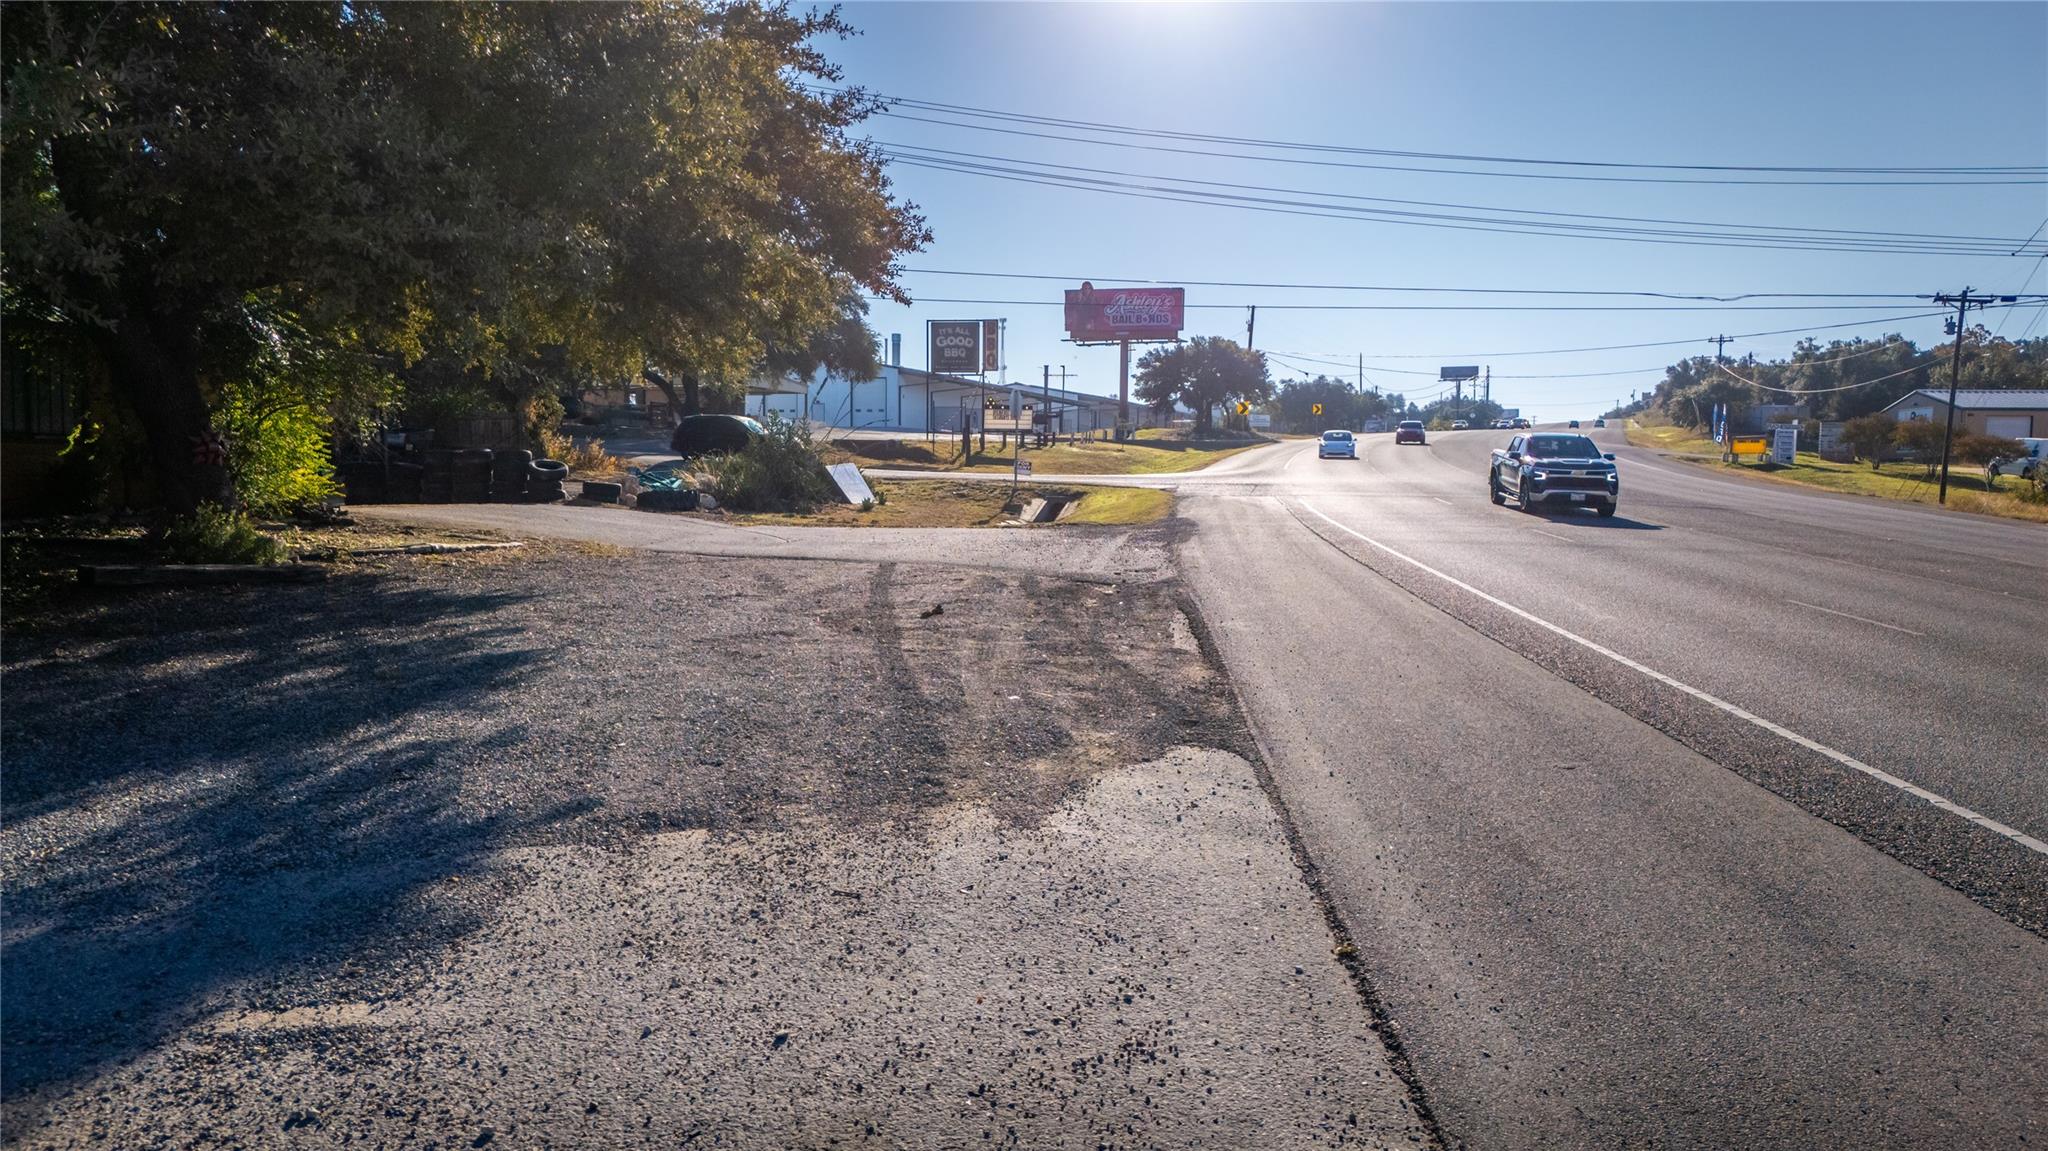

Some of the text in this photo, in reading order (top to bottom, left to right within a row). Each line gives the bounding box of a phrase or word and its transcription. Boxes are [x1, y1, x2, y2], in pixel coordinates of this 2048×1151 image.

[1111, 314, 1134, 324] BAIL
[955, 326, 970, 336] ALL
[936, 335, 975, 348] GOOD
[944, 347, 966, 358] BBQ
